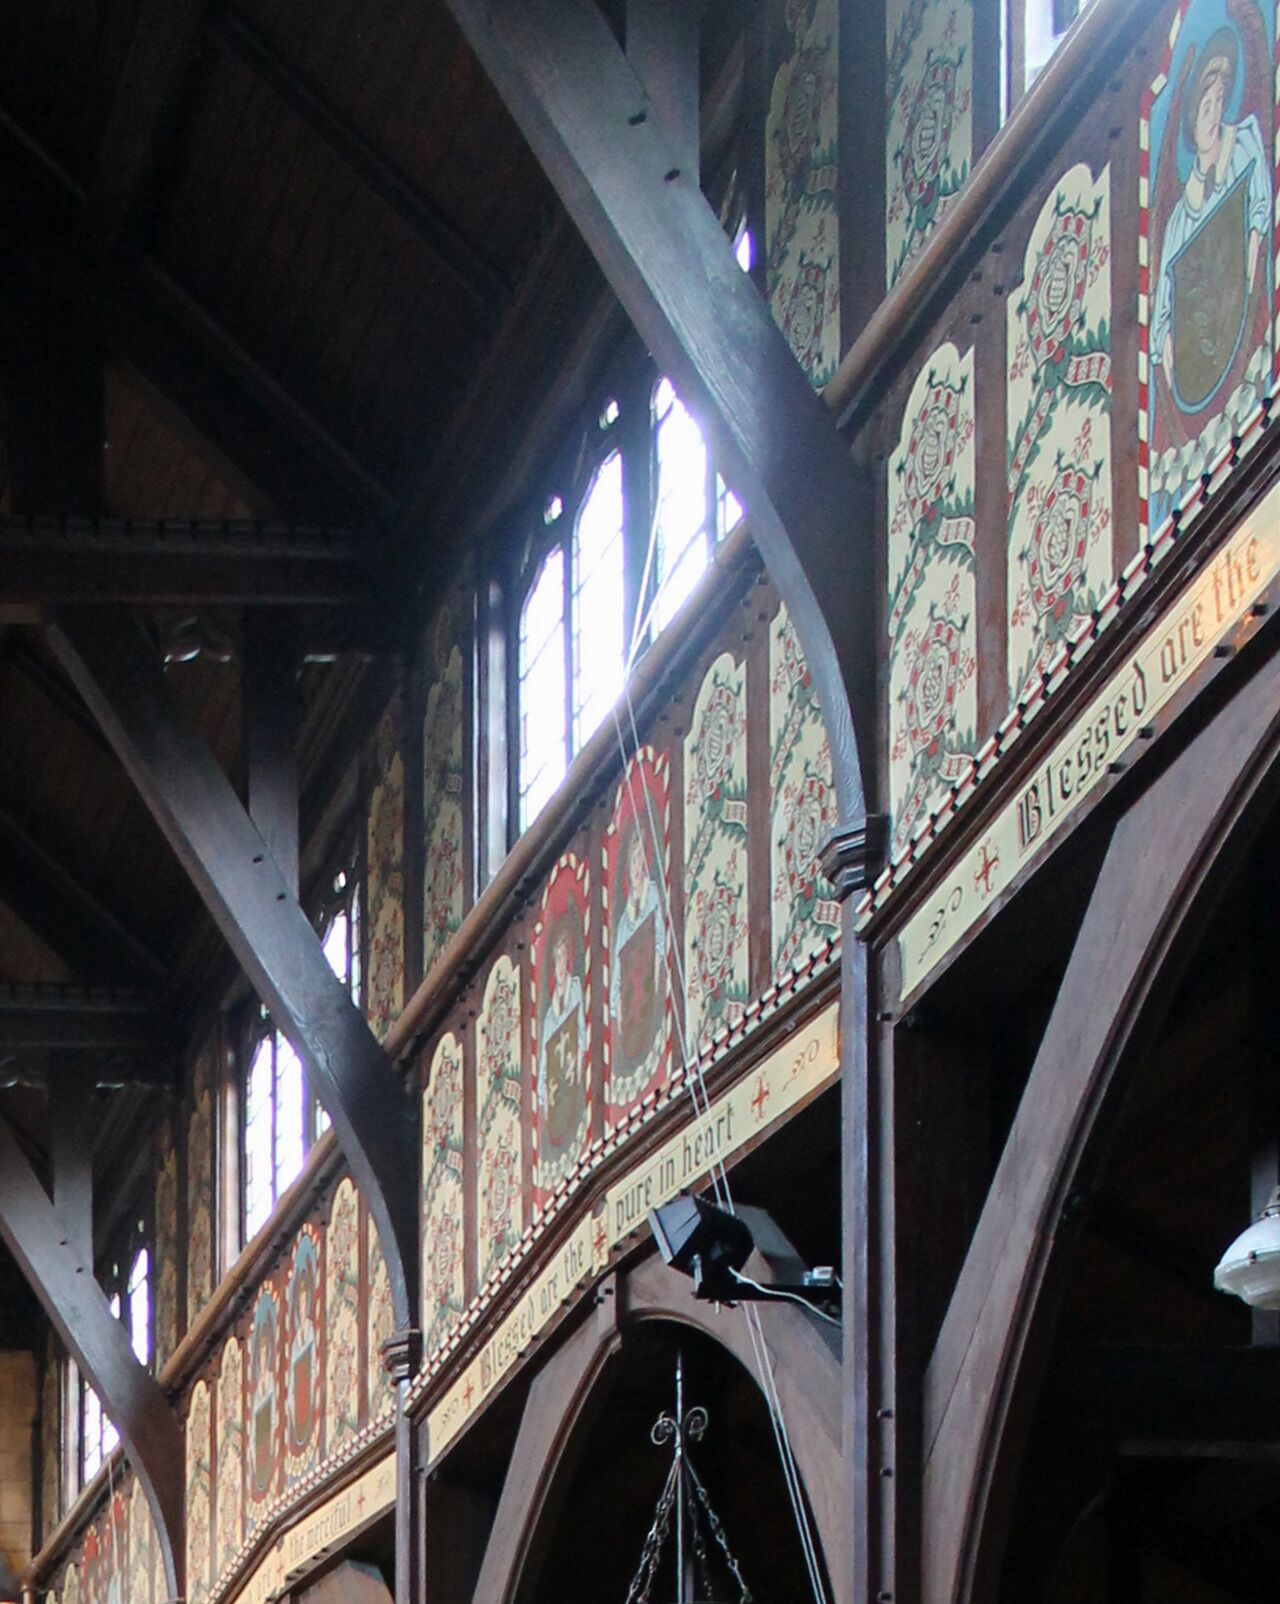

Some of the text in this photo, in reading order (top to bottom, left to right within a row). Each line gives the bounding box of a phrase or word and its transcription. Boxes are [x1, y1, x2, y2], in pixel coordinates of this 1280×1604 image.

[1017, 536, 1261, 852] Blessed are the
[615, 1102, 734, 1232] pure in heart
[480, 1240, 585, 1392] Blessed are the
